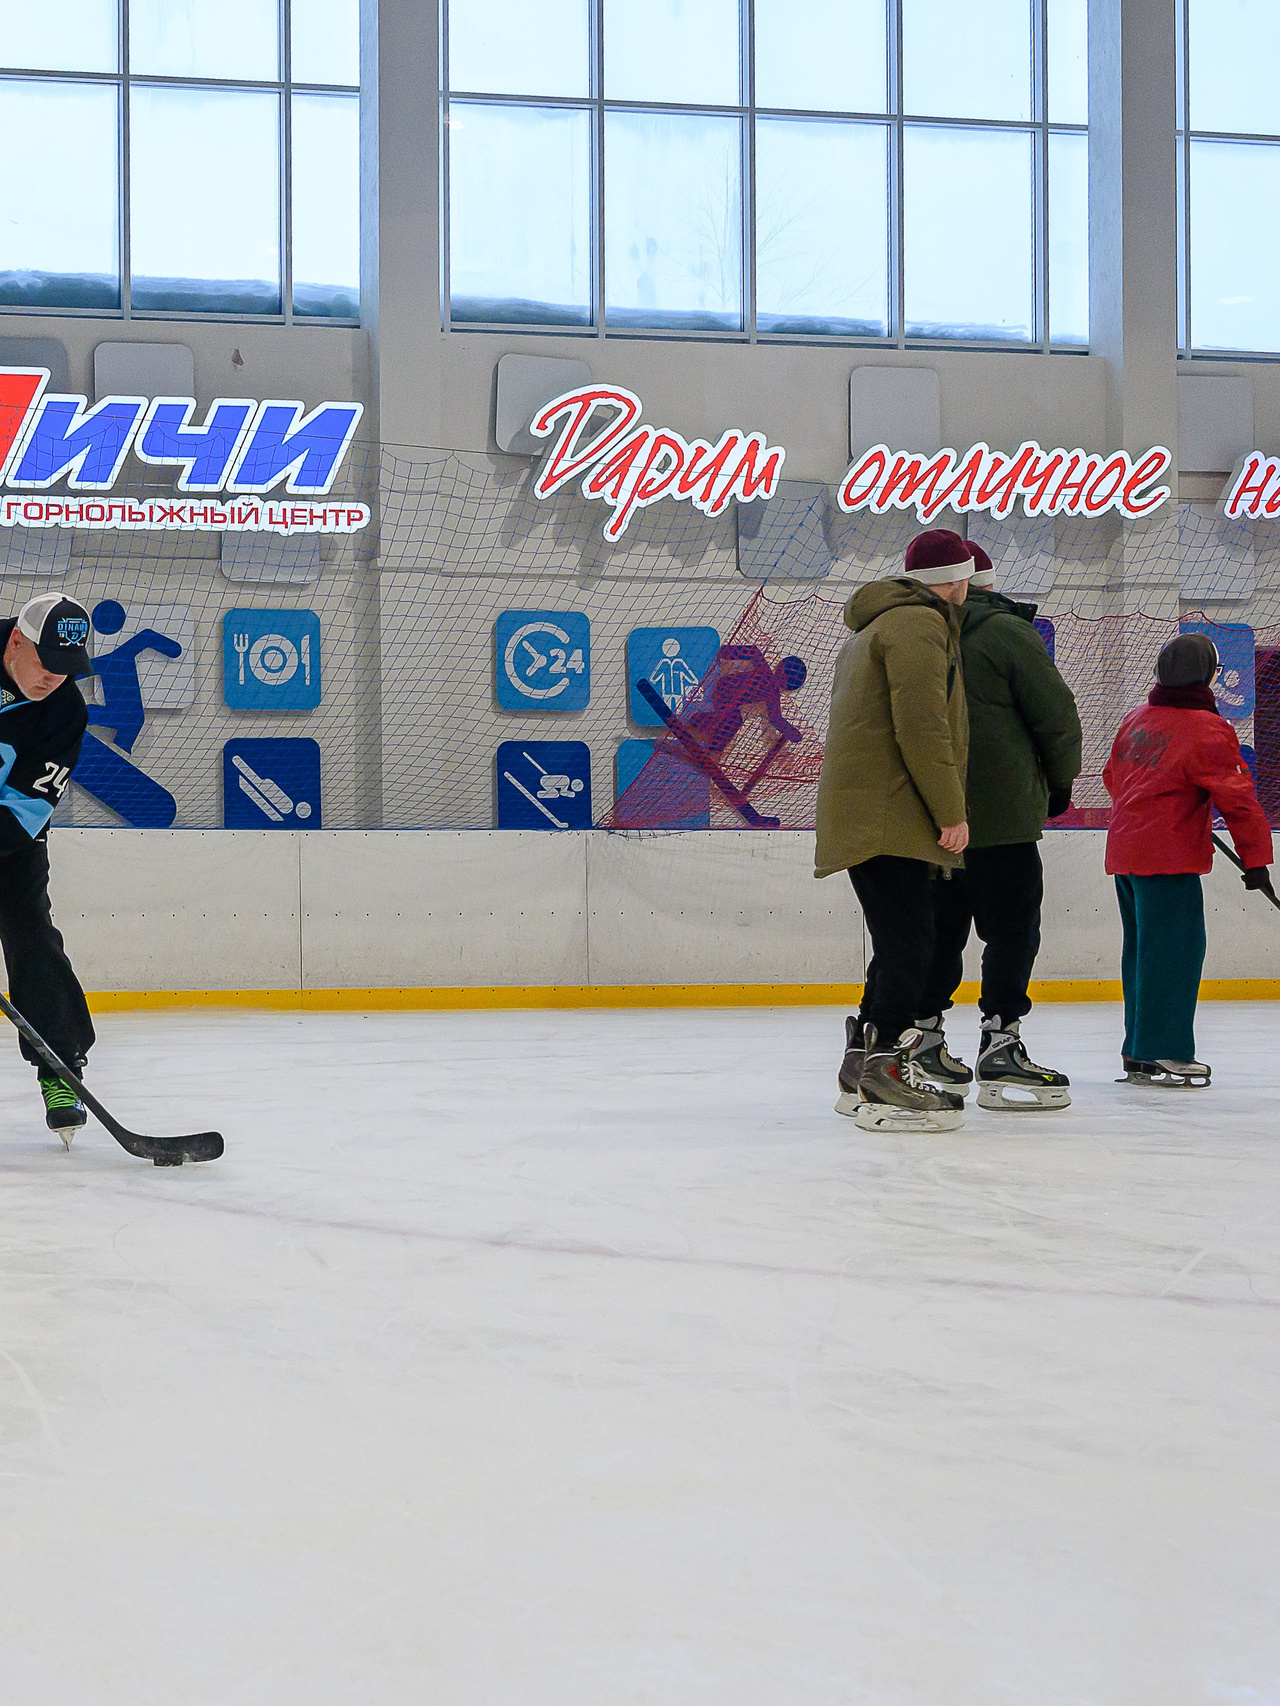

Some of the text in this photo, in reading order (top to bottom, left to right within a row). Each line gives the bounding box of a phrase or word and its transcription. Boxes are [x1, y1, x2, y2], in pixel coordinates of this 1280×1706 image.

[536, 390, 780, 536] Дарим
[843, 446, 1167, 518] отличное
[6, 501, 260, 526] ГОРНОЛЫЖНЫЙ
[269, 508, 365, 529] ЦЕНТР
[548, 648, 586, 674] 24
[32, 760, 70, 798] 24
